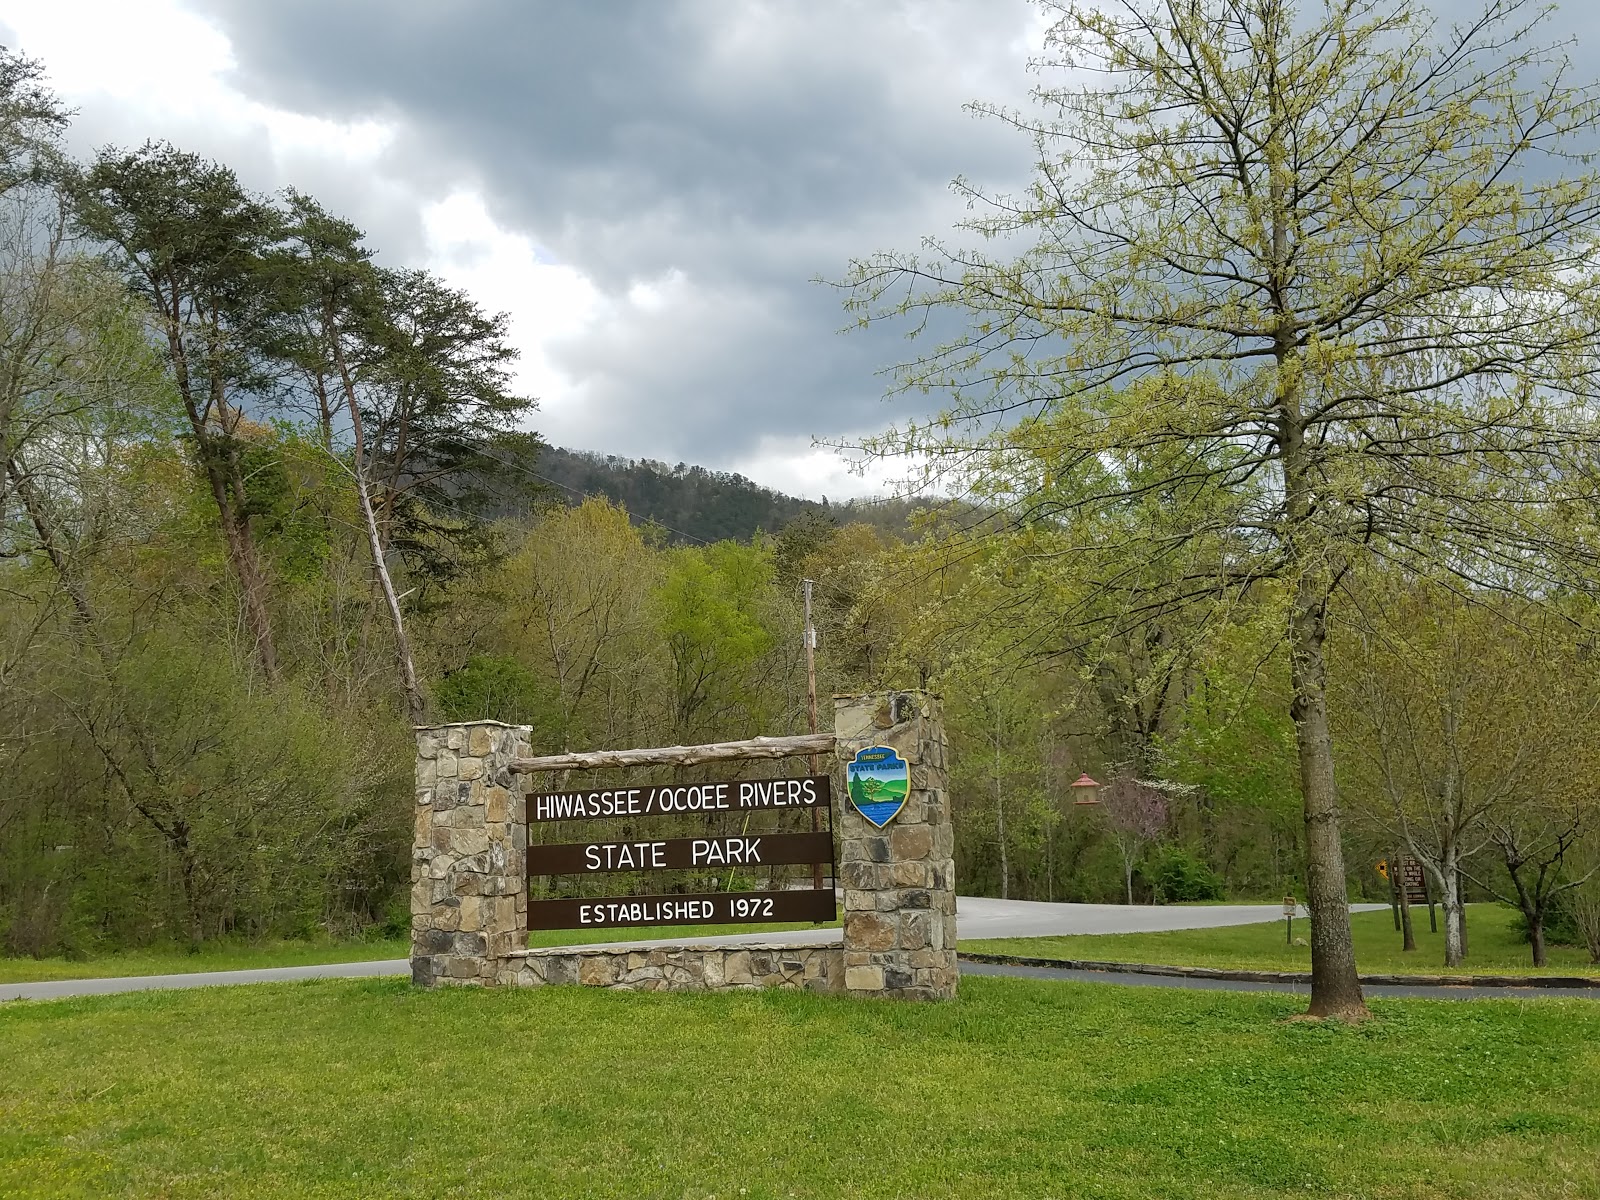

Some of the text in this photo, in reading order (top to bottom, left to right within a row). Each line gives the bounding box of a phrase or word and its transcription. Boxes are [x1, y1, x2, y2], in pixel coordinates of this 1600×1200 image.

[850, 762, 904, 772] STATE PARKS
[739, 779, 817, 808] RIVERS
[585, 837, 762, 870] STATE PARK
[579, 898, 774, 924] ESTABLISHED 1972
